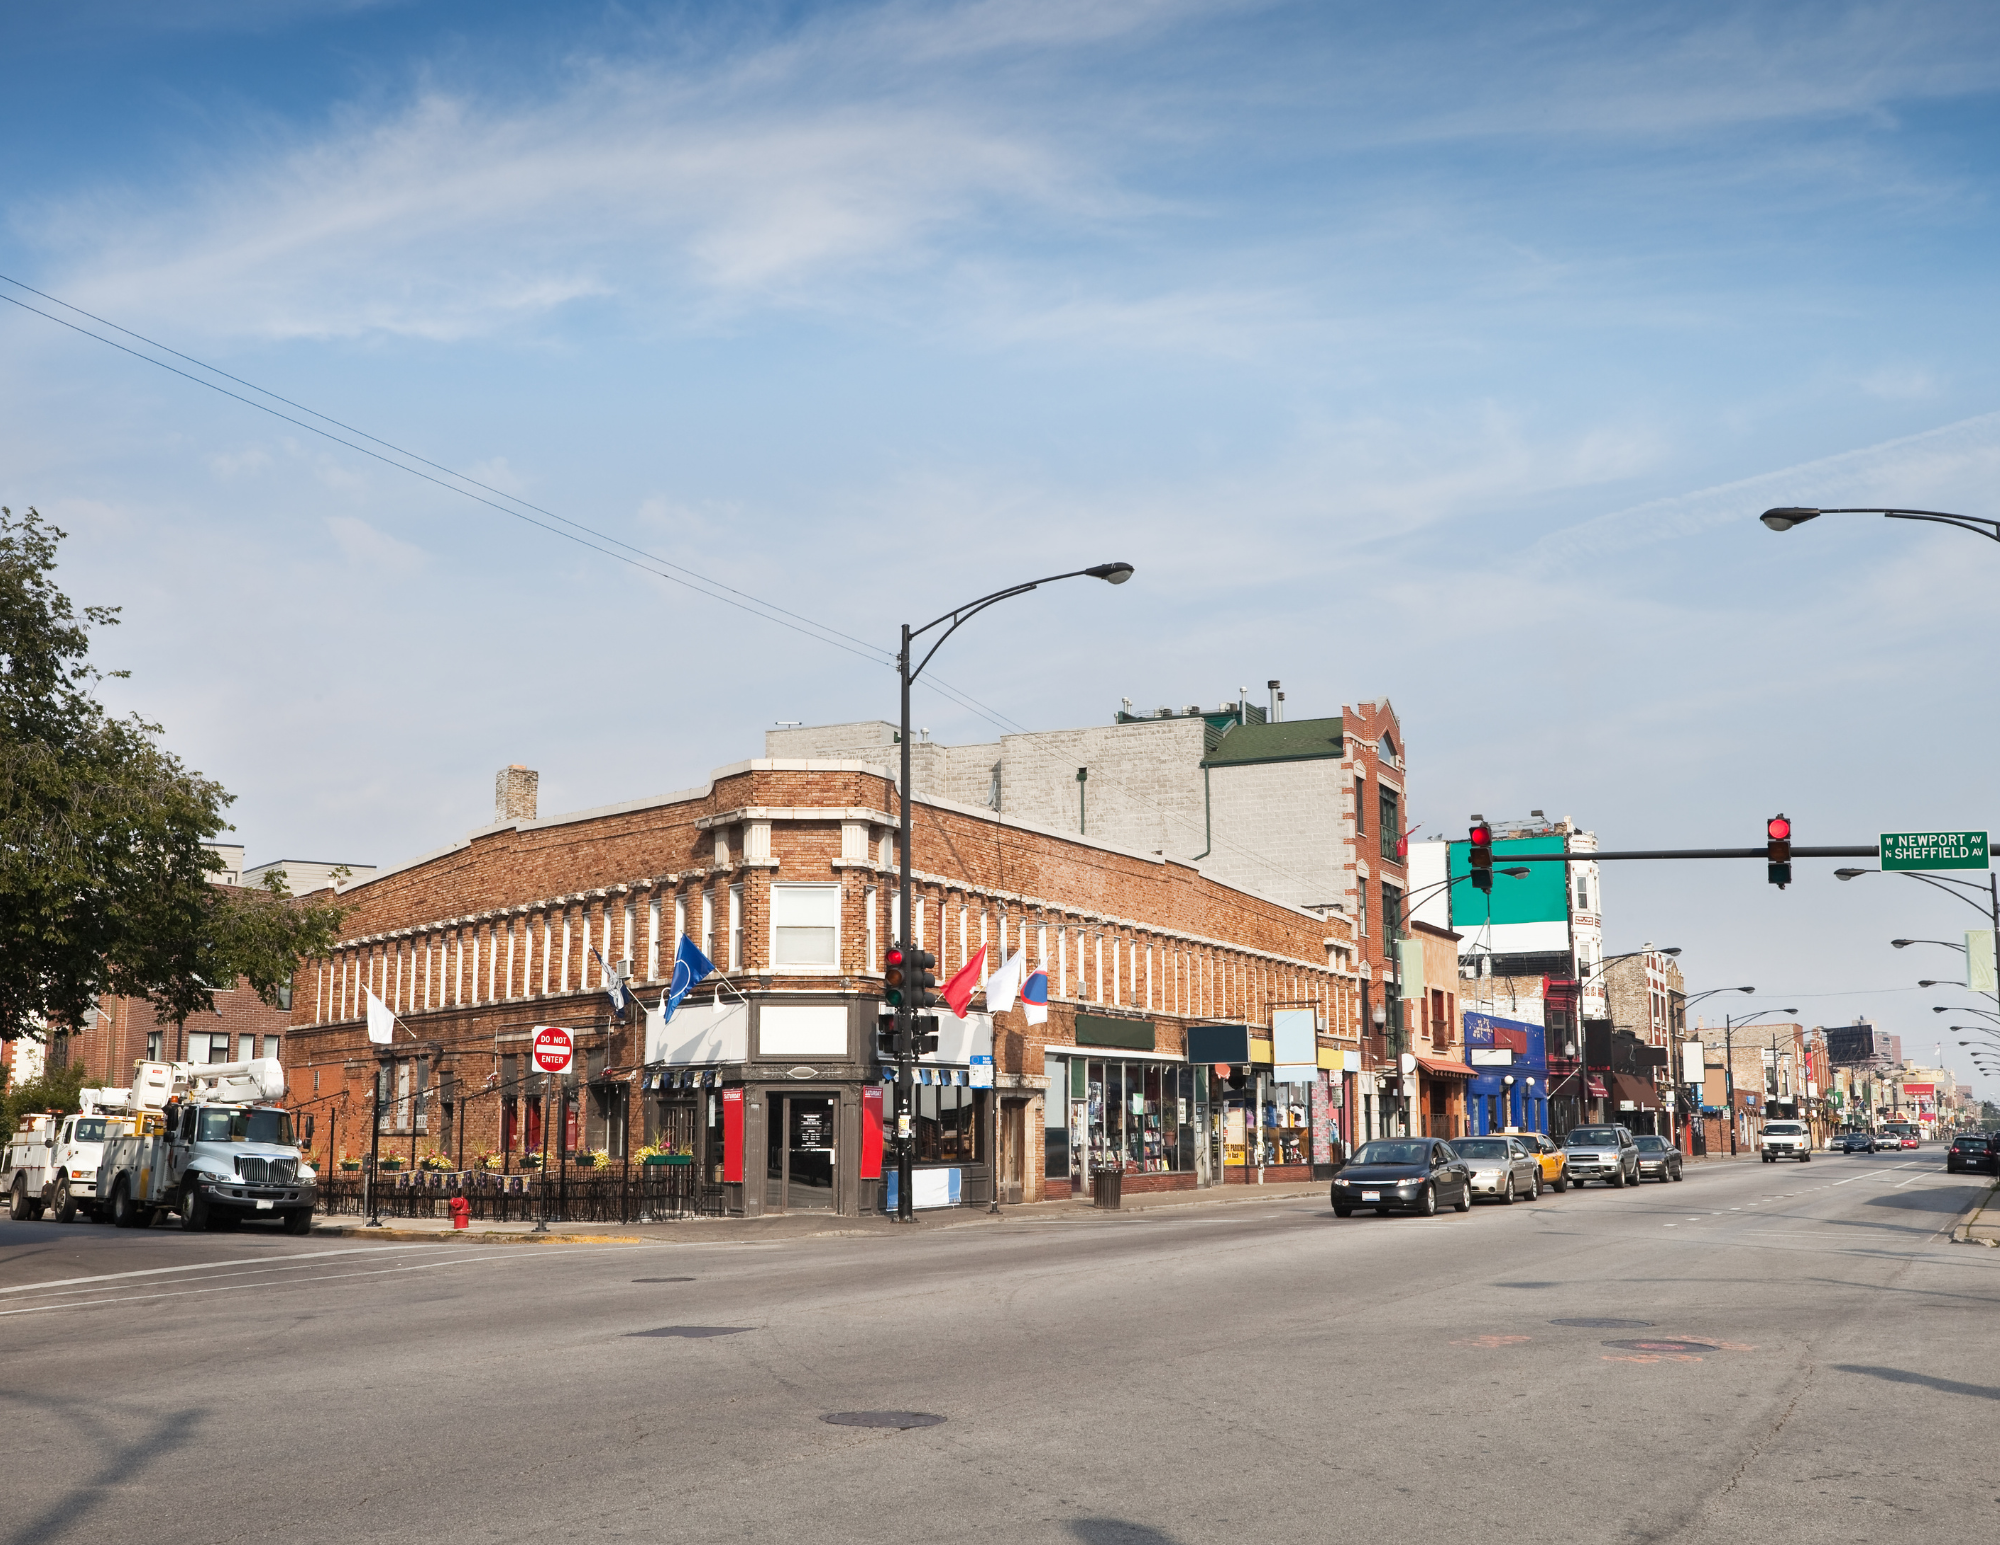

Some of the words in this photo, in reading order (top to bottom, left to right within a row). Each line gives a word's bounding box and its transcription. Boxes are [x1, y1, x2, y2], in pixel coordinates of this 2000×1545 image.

[1886, 837, 1893, 846] W
[1899, 835, 1965, 847] NEWPORT
[1970, 835, 1982, 844] AV
[1885, 850, 1892, 858] N
[1895, 847, 1969, 859] SHEFFIELD
[1972, 848, 1984, 857] AV
[541, 1035, 551, 1043] DO
[553, 1036, 567, 1045] NOT
[541, 1055, 564, 1064] ENTER
